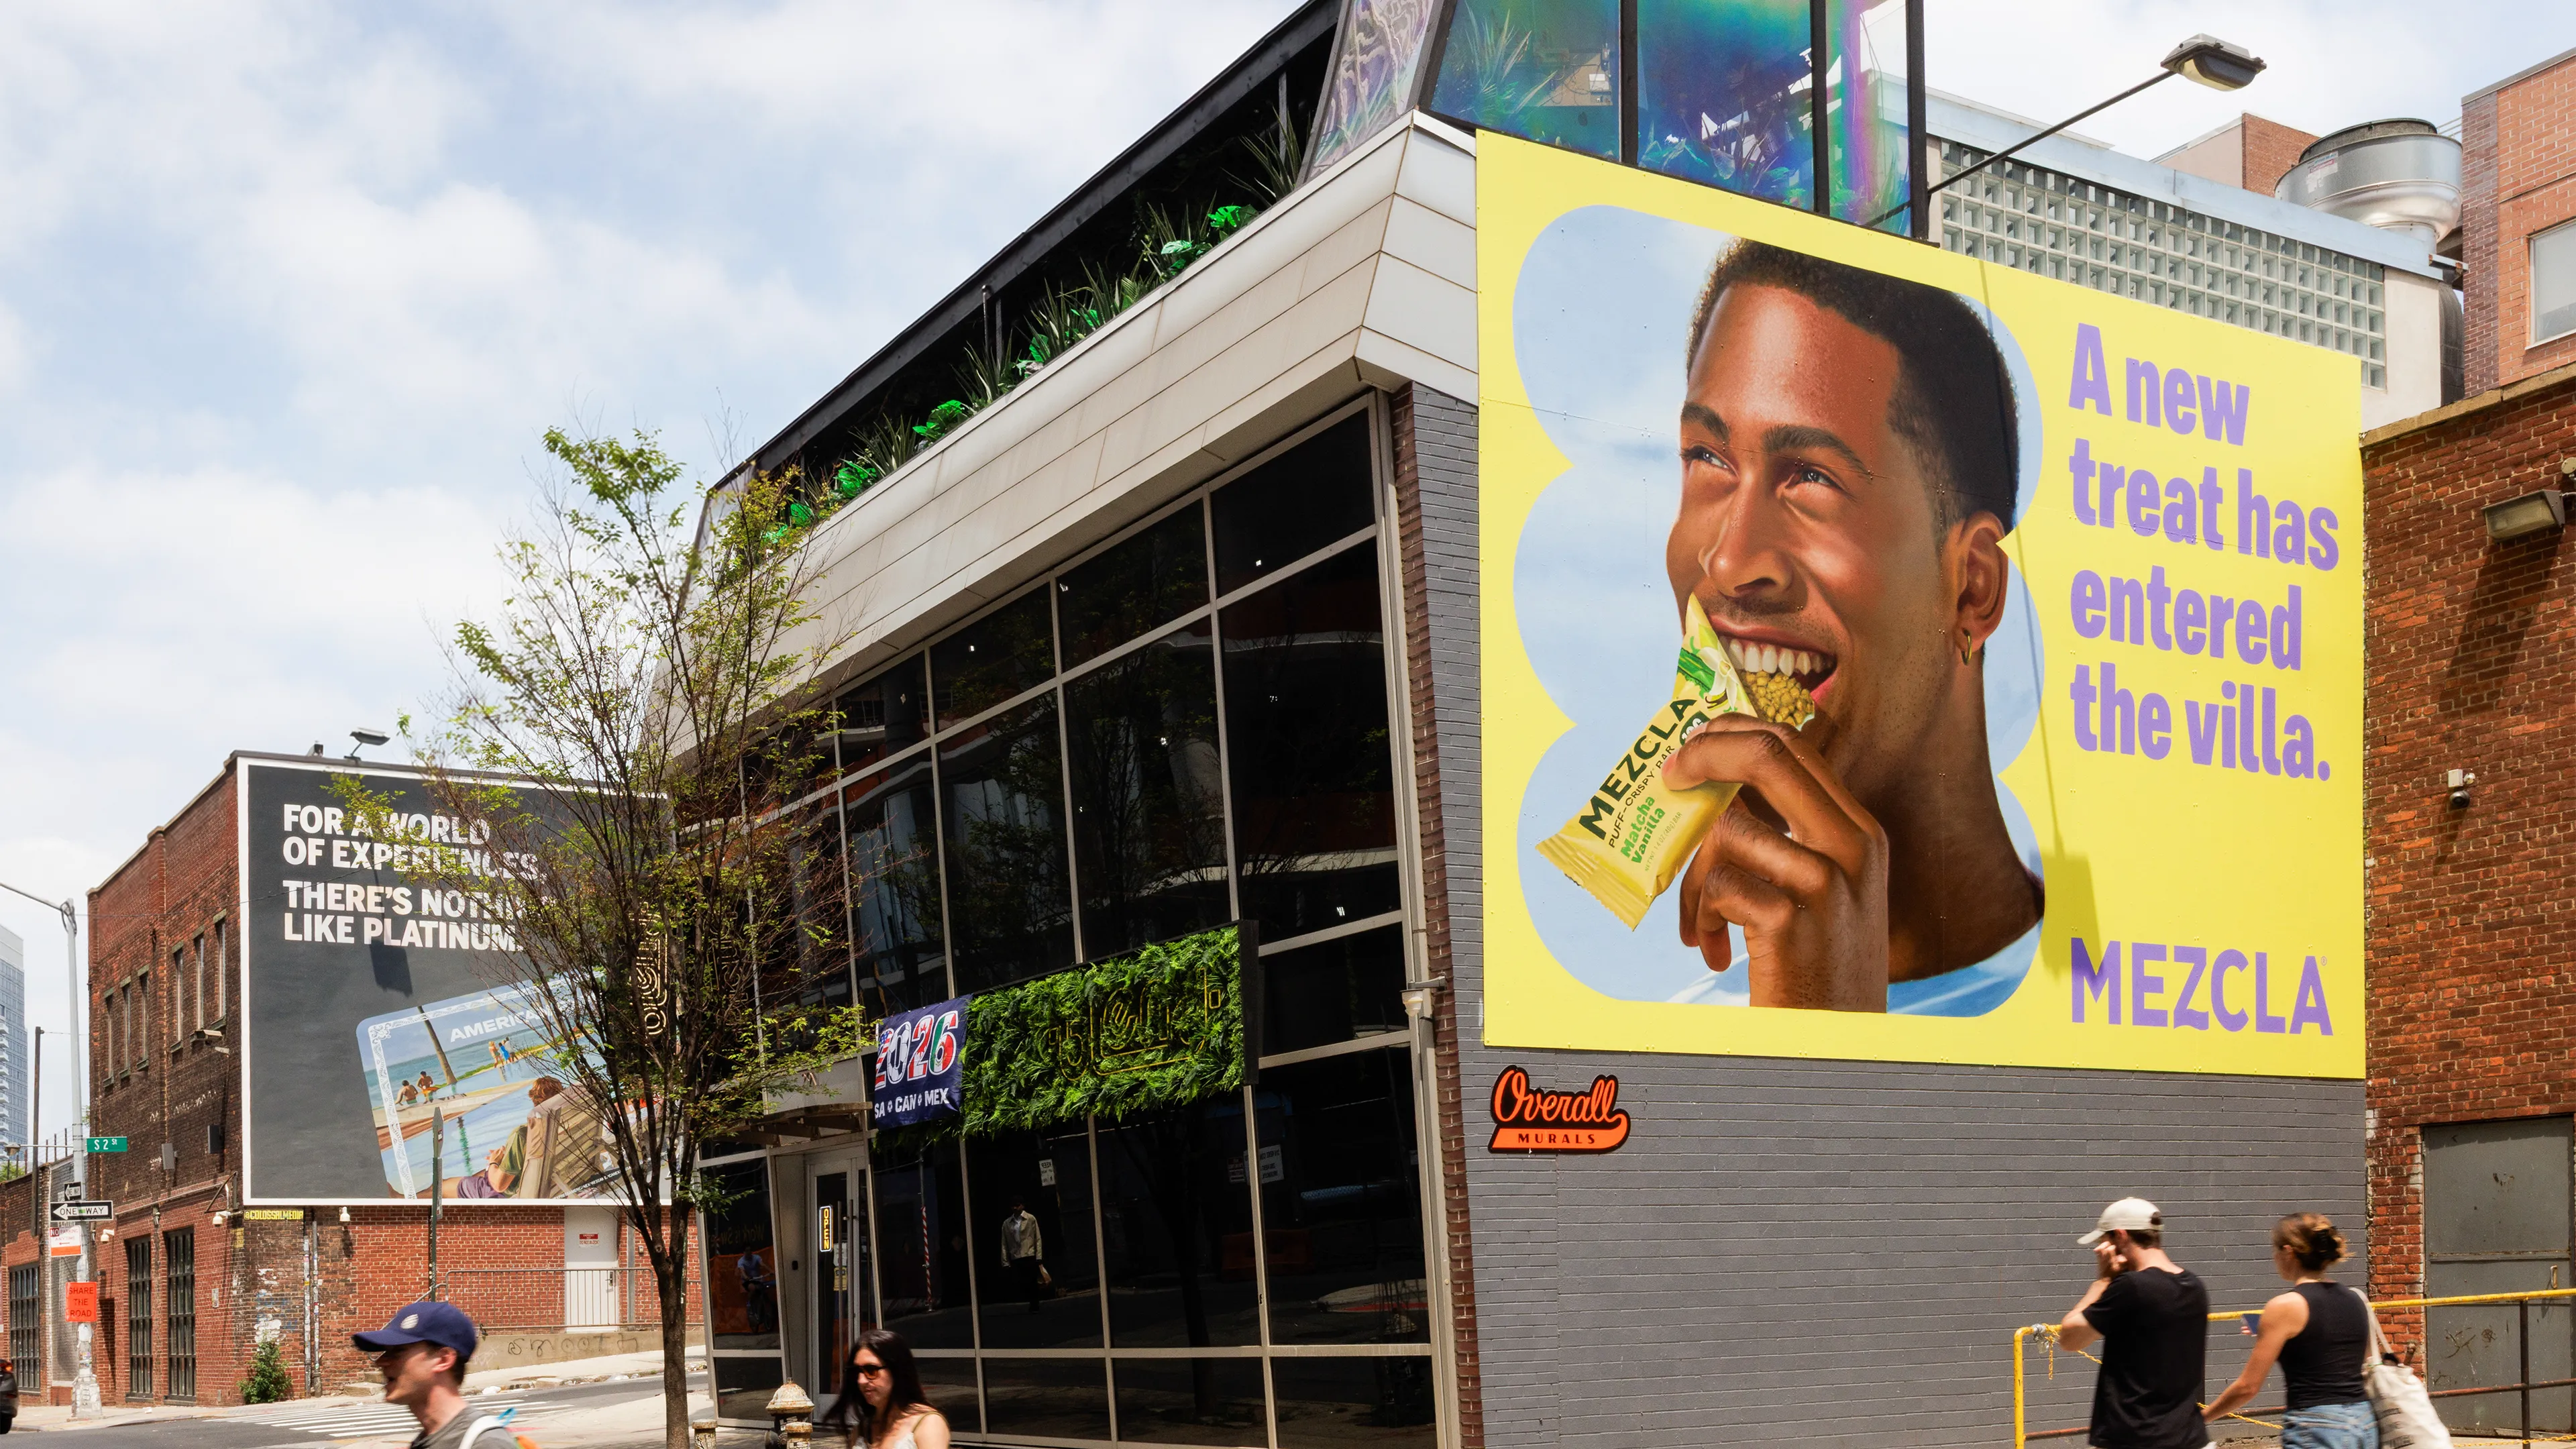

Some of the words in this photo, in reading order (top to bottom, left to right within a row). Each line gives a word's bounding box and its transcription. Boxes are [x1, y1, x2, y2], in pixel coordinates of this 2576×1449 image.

[2068, 323, 2112, 417] A
[2125, 357, 2250, 446] new
[2069, 437, 2224, 551] treat
[2237, 467, 2339, 571] has
[2070, 565, 2302, 671] entered
[2070, 661, 2171, 761] the
[2184, 680, 2330, 782] villa.
[1578, 698, 1698, 841] MEZCLA
[284, 804, 344, 836] FOR
[351, 809, 374, 837] A
[379, 810, 490, 845] WORLD
[1620, 796, 1655, 858] Matcha
[1631, 808, 1666, 864] Vanilla
[282, 836, 325, 866] OF
[282, 879, 413, 916] THERE'S
[284, 912, 355, 944] LIKE
[875, 1010, 959, 1091] 2026
[895, 1093, 916, 1112] CAN
[924, 1087, 950, 1107] MEX
[1494, 1069, 1618, 1122] Overall
[94, 1139, 100, 1150] S
[103, 1139, 109, 1150] 2
[1518, 1133, 1595, 1144] MURALS
[50, 1228, 59, 1236] NO
[244, 1210, 304, 1220] @COLOSSALMEDIA
[68, 1287, 94, 1295] SHARE
